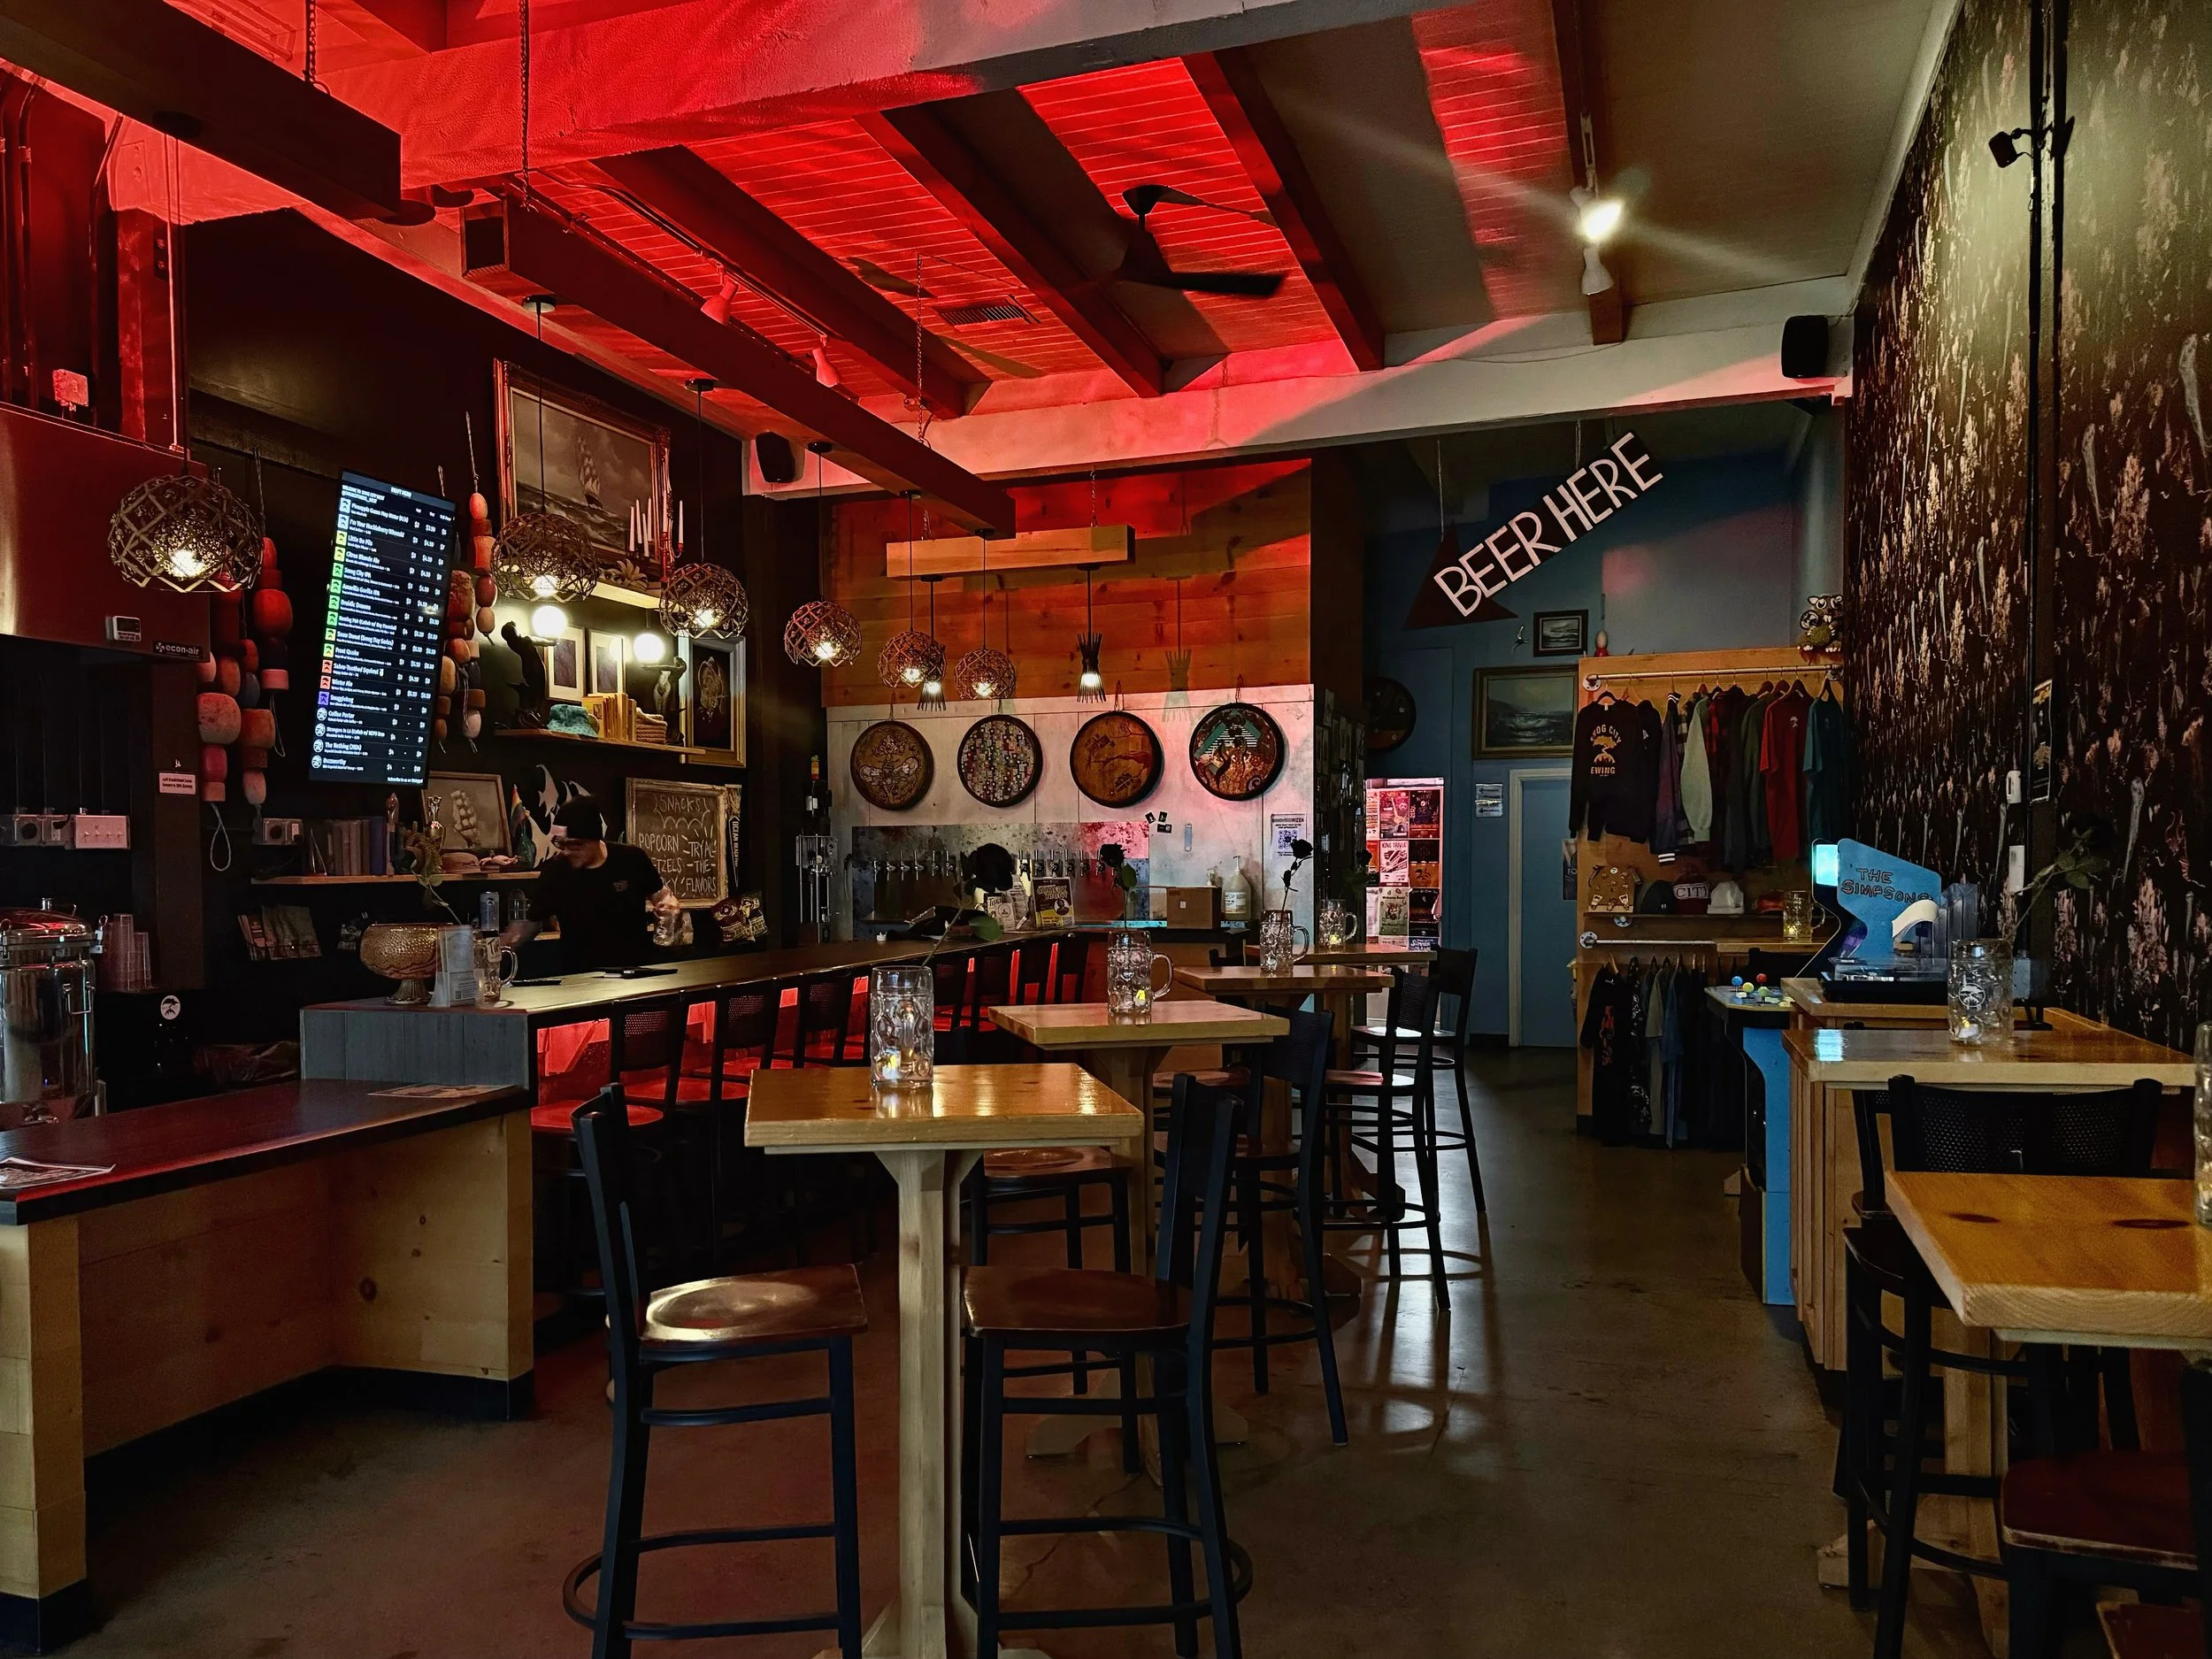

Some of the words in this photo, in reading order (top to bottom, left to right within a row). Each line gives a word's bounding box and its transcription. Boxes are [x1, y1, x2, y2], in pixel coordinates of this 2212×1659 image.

[1433, 511, 1563, 617] BEER
[1542, 432, 1663, 542] HERE
[639, 833, 679, 853] POPCORN
[688, 840, 704, 858] TRY
[651, 857, 682, 874] ETZELS
[694, 859, 711, 874] THE
[1855, 867, 1893, 884] THE
[686, 876, 717, 894] FLAVORS
